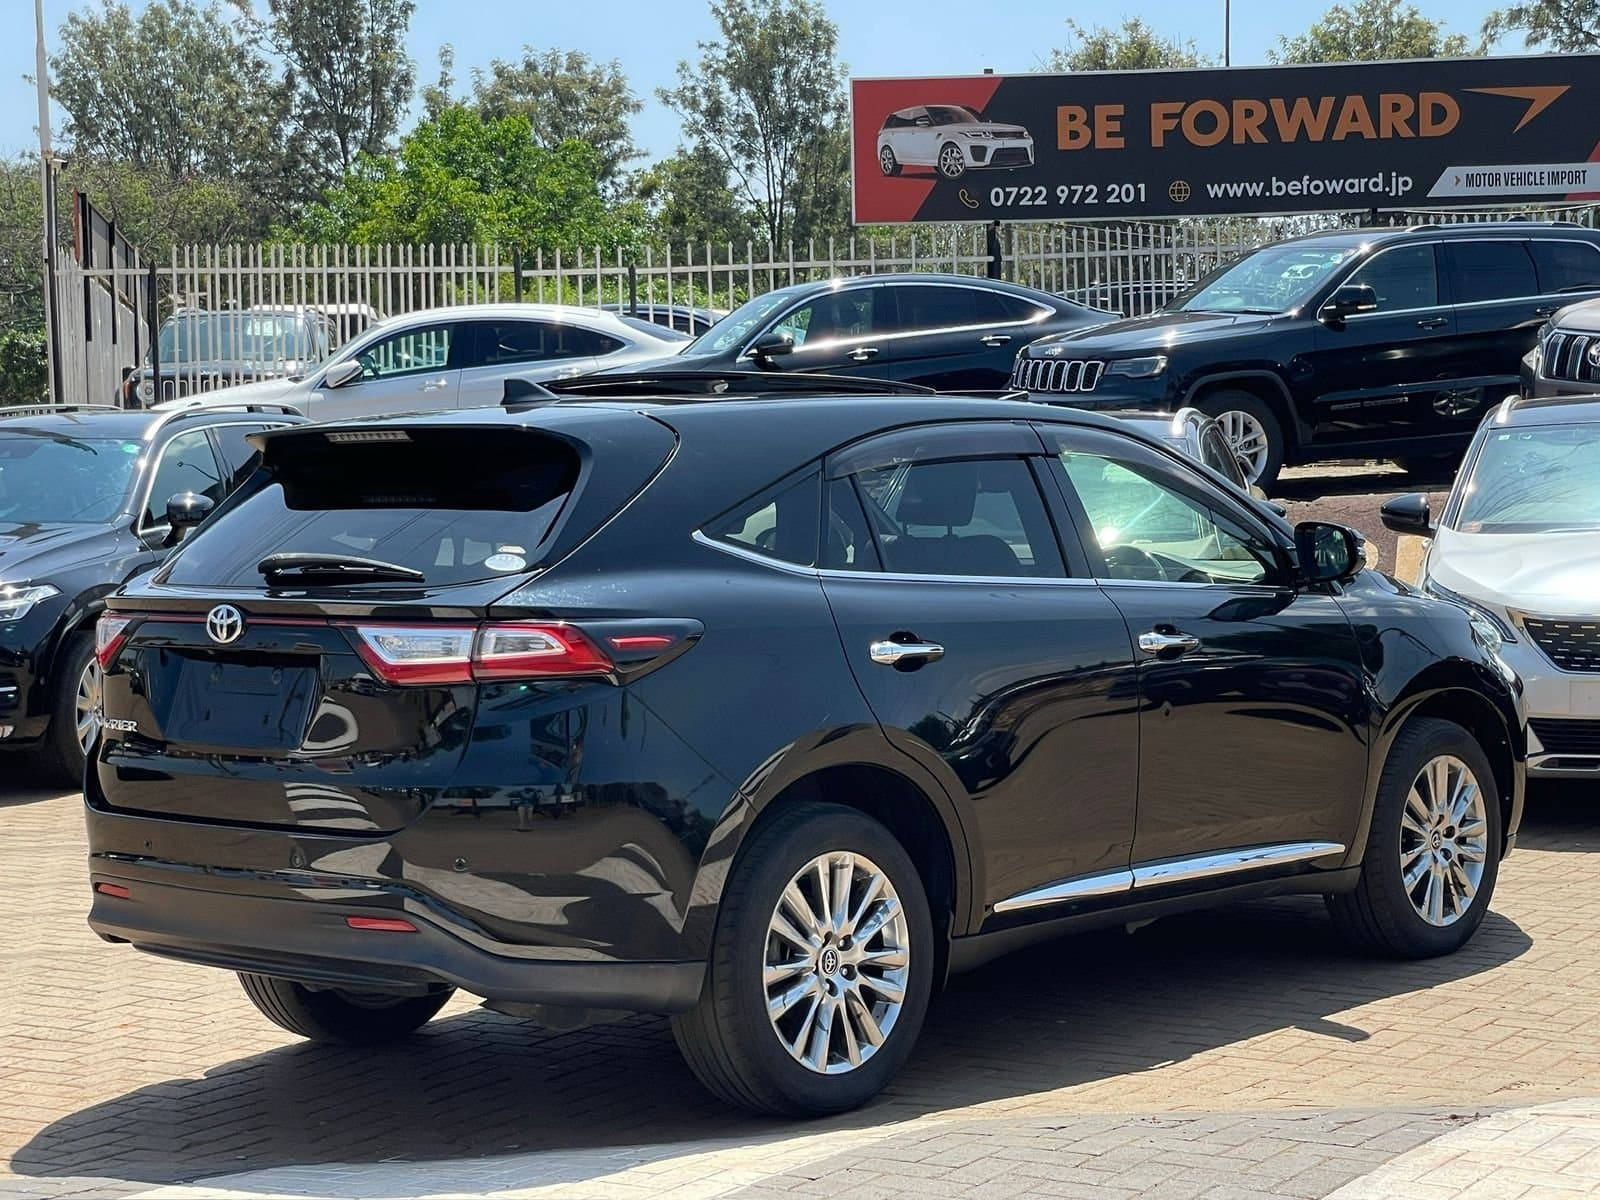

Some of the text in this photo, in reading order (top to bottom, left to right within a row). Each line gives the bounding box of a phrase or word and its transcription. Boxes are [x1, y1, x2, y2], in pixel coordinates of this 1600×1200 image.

[1057, 92, 1460, 150] BE FORWARD
[1206, 171, 1413, 198] www.befoward.jp
[1465, 170, 1587, 188] MOTOR VEHICLE IMPORT
[990, 183, 1147, 207] 0722 972 201
